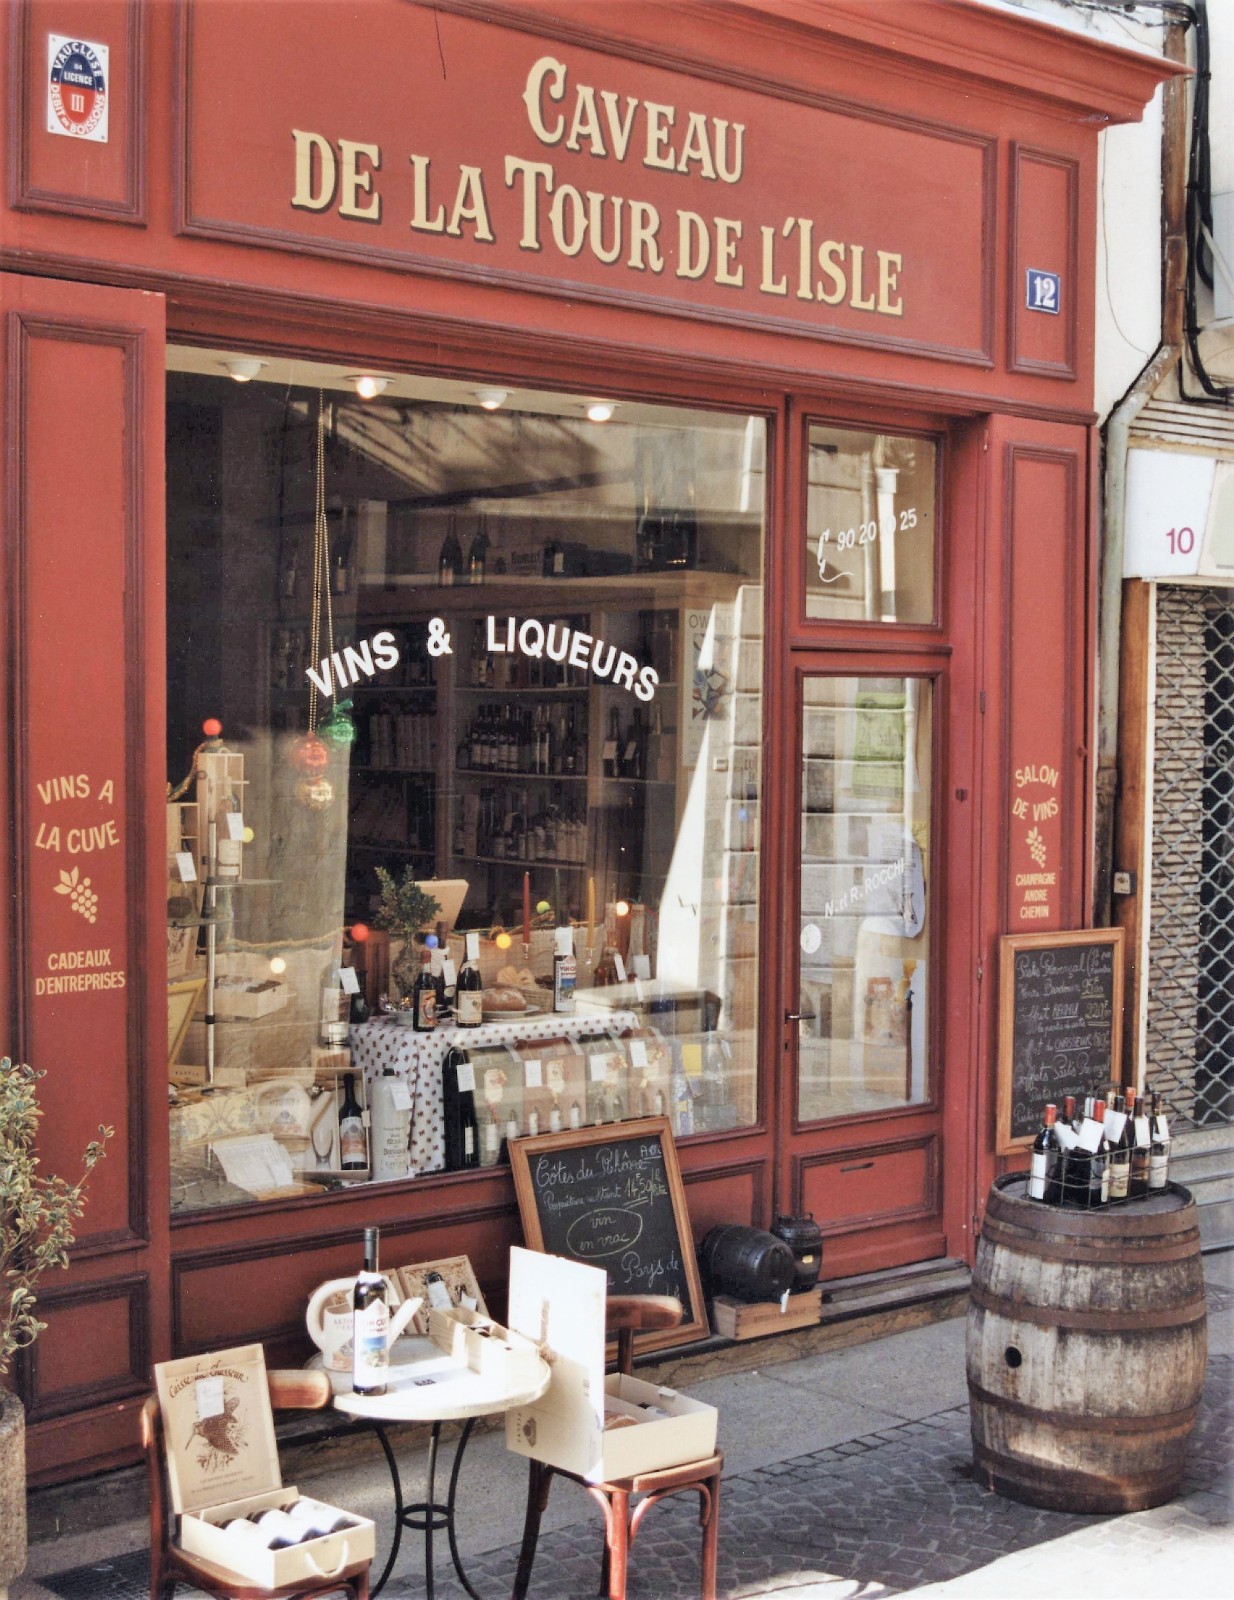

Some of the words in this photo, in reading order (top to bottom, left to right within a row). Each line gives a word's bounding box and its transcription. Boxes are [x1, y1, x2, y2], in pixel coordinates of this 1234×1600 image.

[53, 42, 102, 77] VAUCLUSE
[64, 71, 93, 85] LICENCE
[51, 85, 66, 116] DEBIT
[70, 94, 105, 135] BOISSONS
[71, 93, 84, 113] III
[522, 56, 746, 184] CAVEAU
[291, 129, 380, 222] DE
[410, 154, 495, 242] LA
[504, 155, 665, 273] TOUR
[676, 209, 744, 288] DE
[760, 216, 904, 317] L'ISLE
[1032, 276, 1056, 309] 12
[837, 528, 856, 551] 90
[858, 521, 877, 545] 20
[900, 508, 918, 531] 25
[1166, 527, 1195, 555] 10
[306, 632, 400, 698] VINS
[427, 617, 454, 657] &
[487, 616, 660, 702] LIQUEURS
[1015, 765, 1059, 788] SALON
[37, 774, 91, 805] VINS
[98, 779, 114, 804] A
[1012, 797, 1030, 820] DE
[1033, 797, 1059, 822] VINS
[35, 822, 61, 852] LA
[67, 820, 120, 854] CUVE
[1016, 873, 1056, 886] CHAMPAGNE
[1024, 889, 1047, 902] ANDRE
[1020, 905, 1049, 919] CHEMIN
[48, 949, 112, 971] CADEAUX
[35, 971, 126, 996] D'ENTREPRISES
[577, 1158, 594, 1181] du
[590, 1213, 616, 1229] vin
[580, 1239, 594, 1251] en
[598, 1233, 631, 1247] vrac
[622, 1250, 665, 1288] Pays
[667, 1250, 679, 1271] de
[169, 1375, 193, 1398] Caisse
